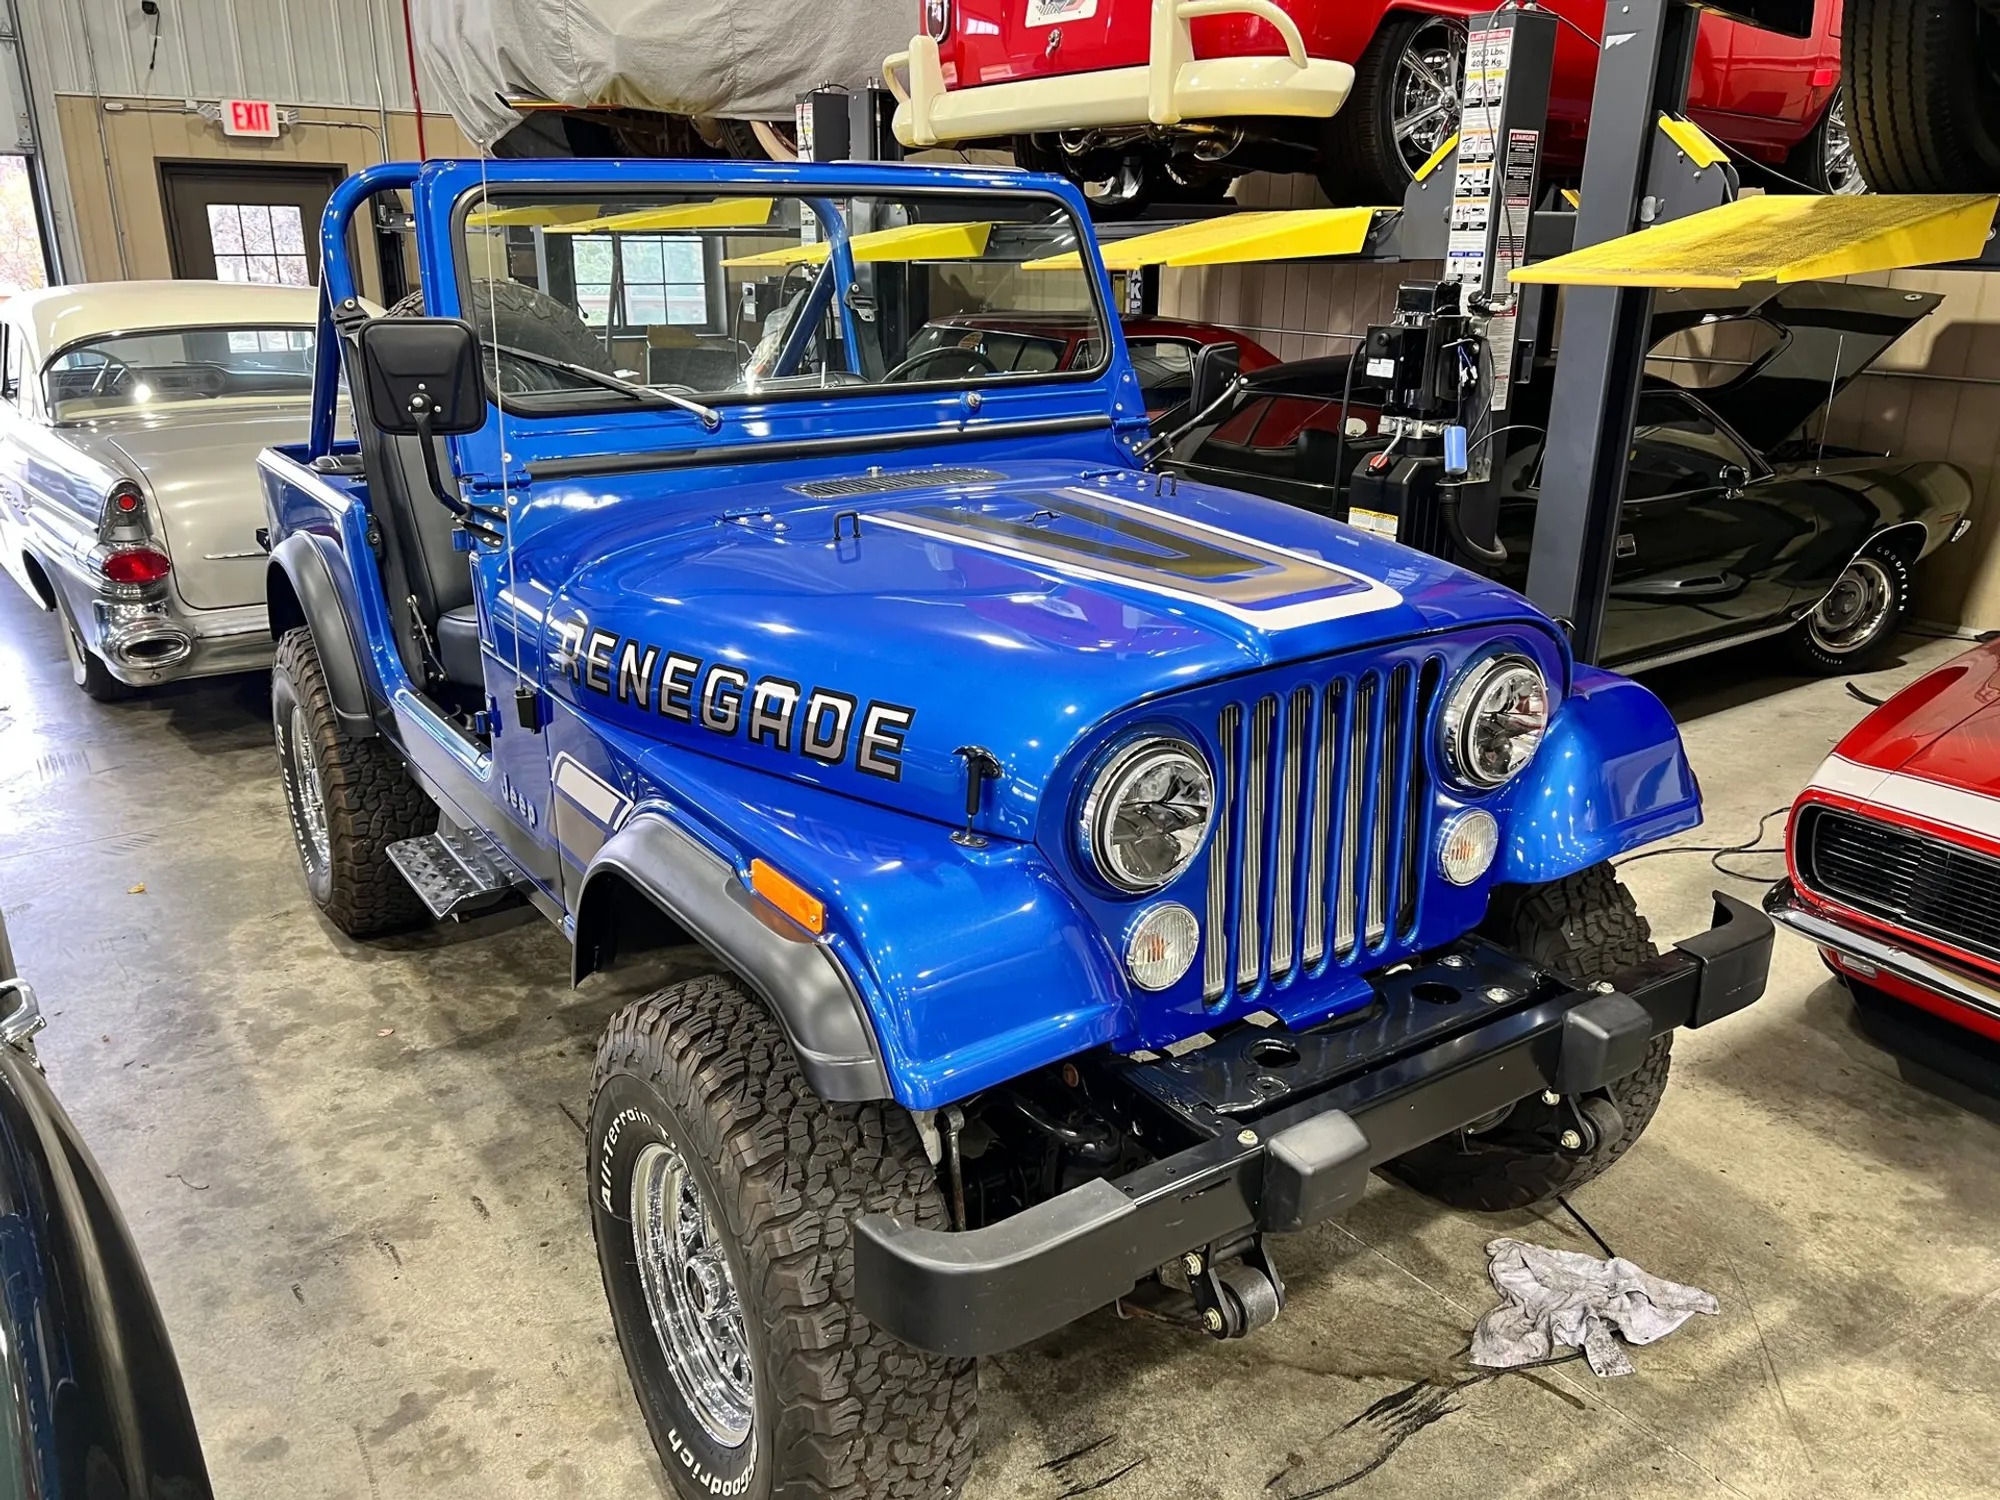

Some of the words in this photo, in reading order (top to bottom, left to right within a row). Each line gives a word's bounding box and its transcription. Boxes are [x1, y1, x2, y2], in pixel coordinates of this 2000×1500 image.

[1471, 48, 1489, 58] 9000
[231, 101, 270, 132] EXIT
[558, 619, 917, 783] RENEGADE
[501, 771, 538, 829] Jeep
[601, 1106, 653, 1213] All-Terrain
